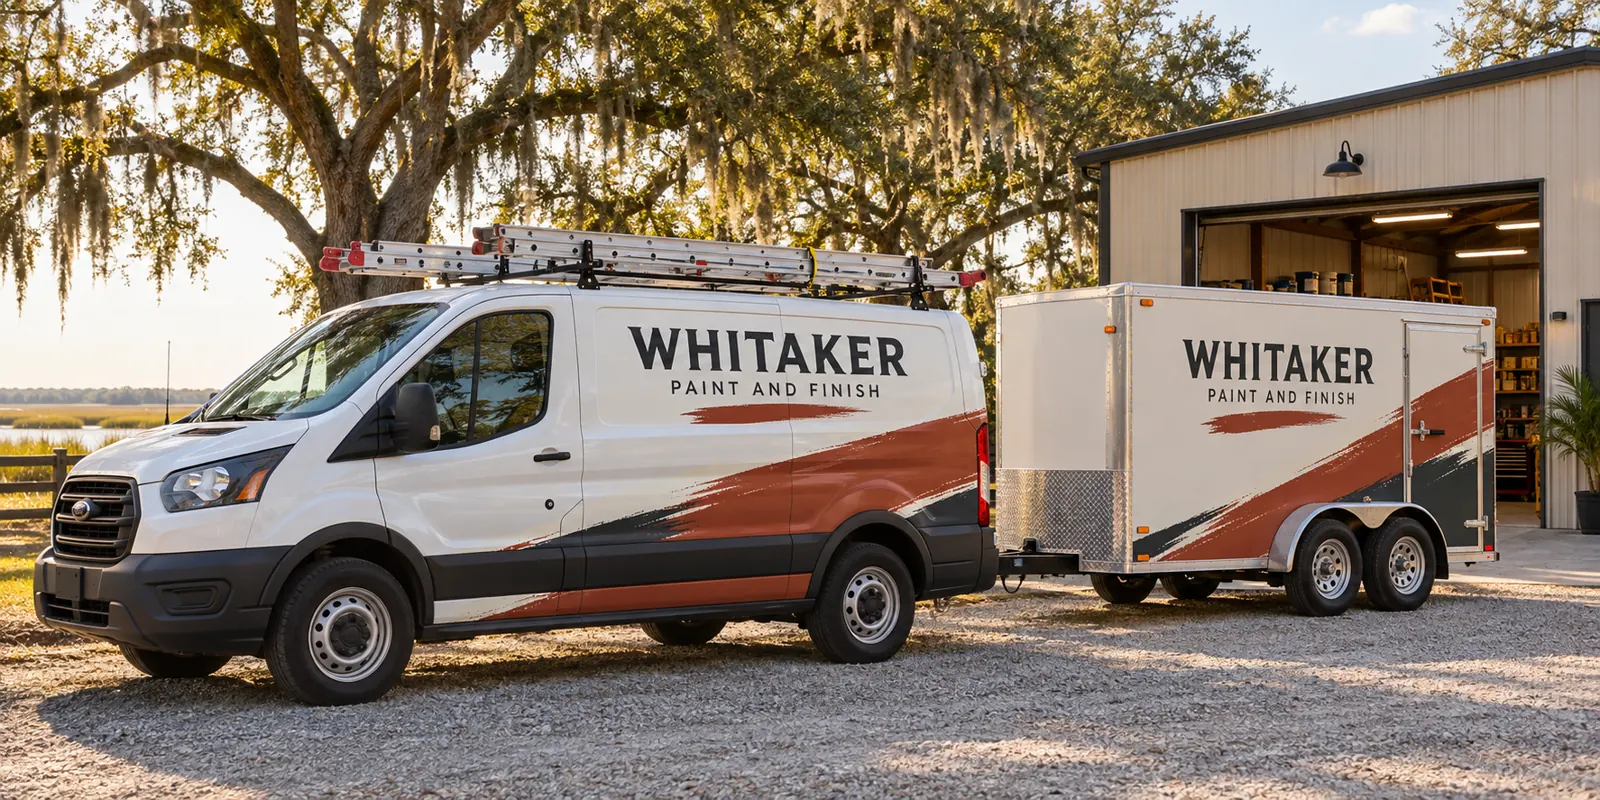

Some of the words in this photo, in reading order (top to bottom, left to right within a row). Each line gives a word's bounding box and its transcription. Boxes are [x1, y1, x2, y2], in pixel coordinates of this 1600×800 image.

[627, 326, 909, 377] WHITAKER
[1182, 338, 1375, 385] WHITAKER
[671, 379, 739, 396] PAINT
[752, 381, 797, 397] AND
[809, 382, 880, 398] FINISH
[1208, 388, 1257, 403] PAINT
[1265, 389, 1297, 404] AND
[1305, 390, 1355, 405] FINISH
